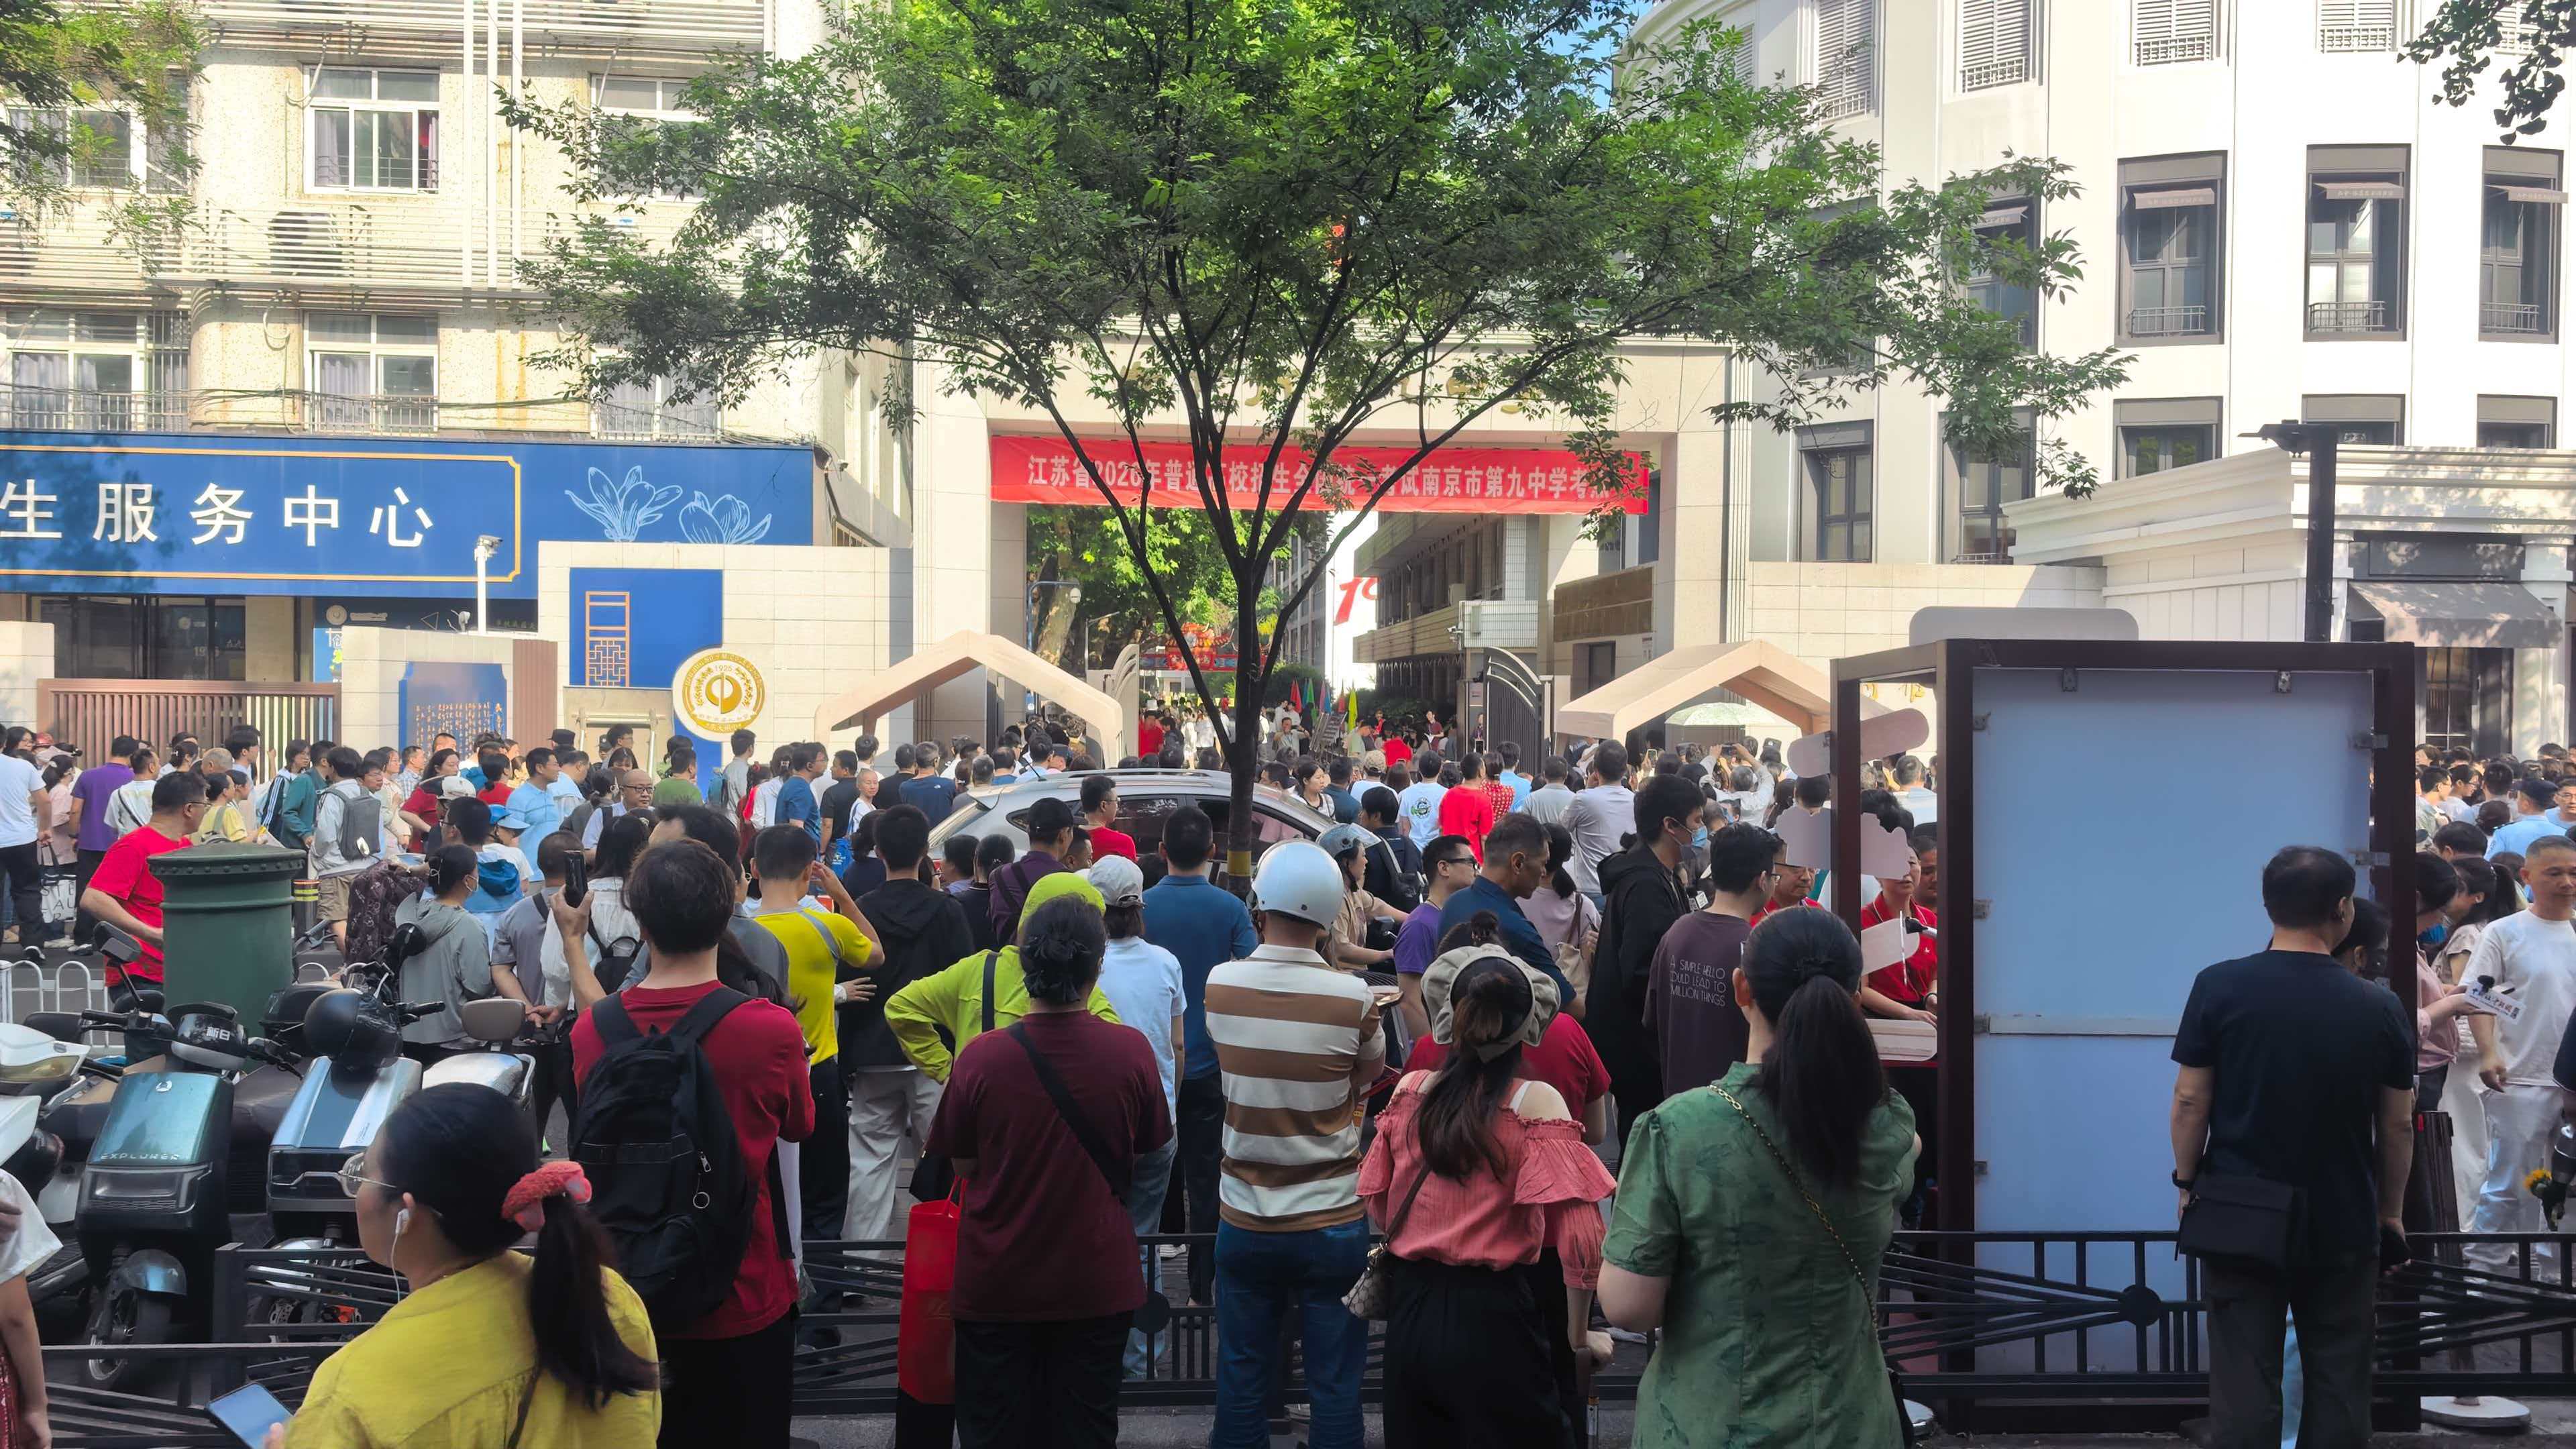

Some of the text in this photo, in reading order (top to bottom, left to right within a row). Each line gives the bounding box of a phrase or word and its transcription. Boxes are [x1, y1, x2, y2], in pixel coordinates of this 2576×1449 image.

[0, 479, 433, 549] 生服务中心
[1670, 955, 1725, 979] A SIMPLE HELLO
[1692, 975, 1711, 989] LEAD
[1714, 981, 1726, 994] TO
[1701, 990, 1725, 1006] THINGS
